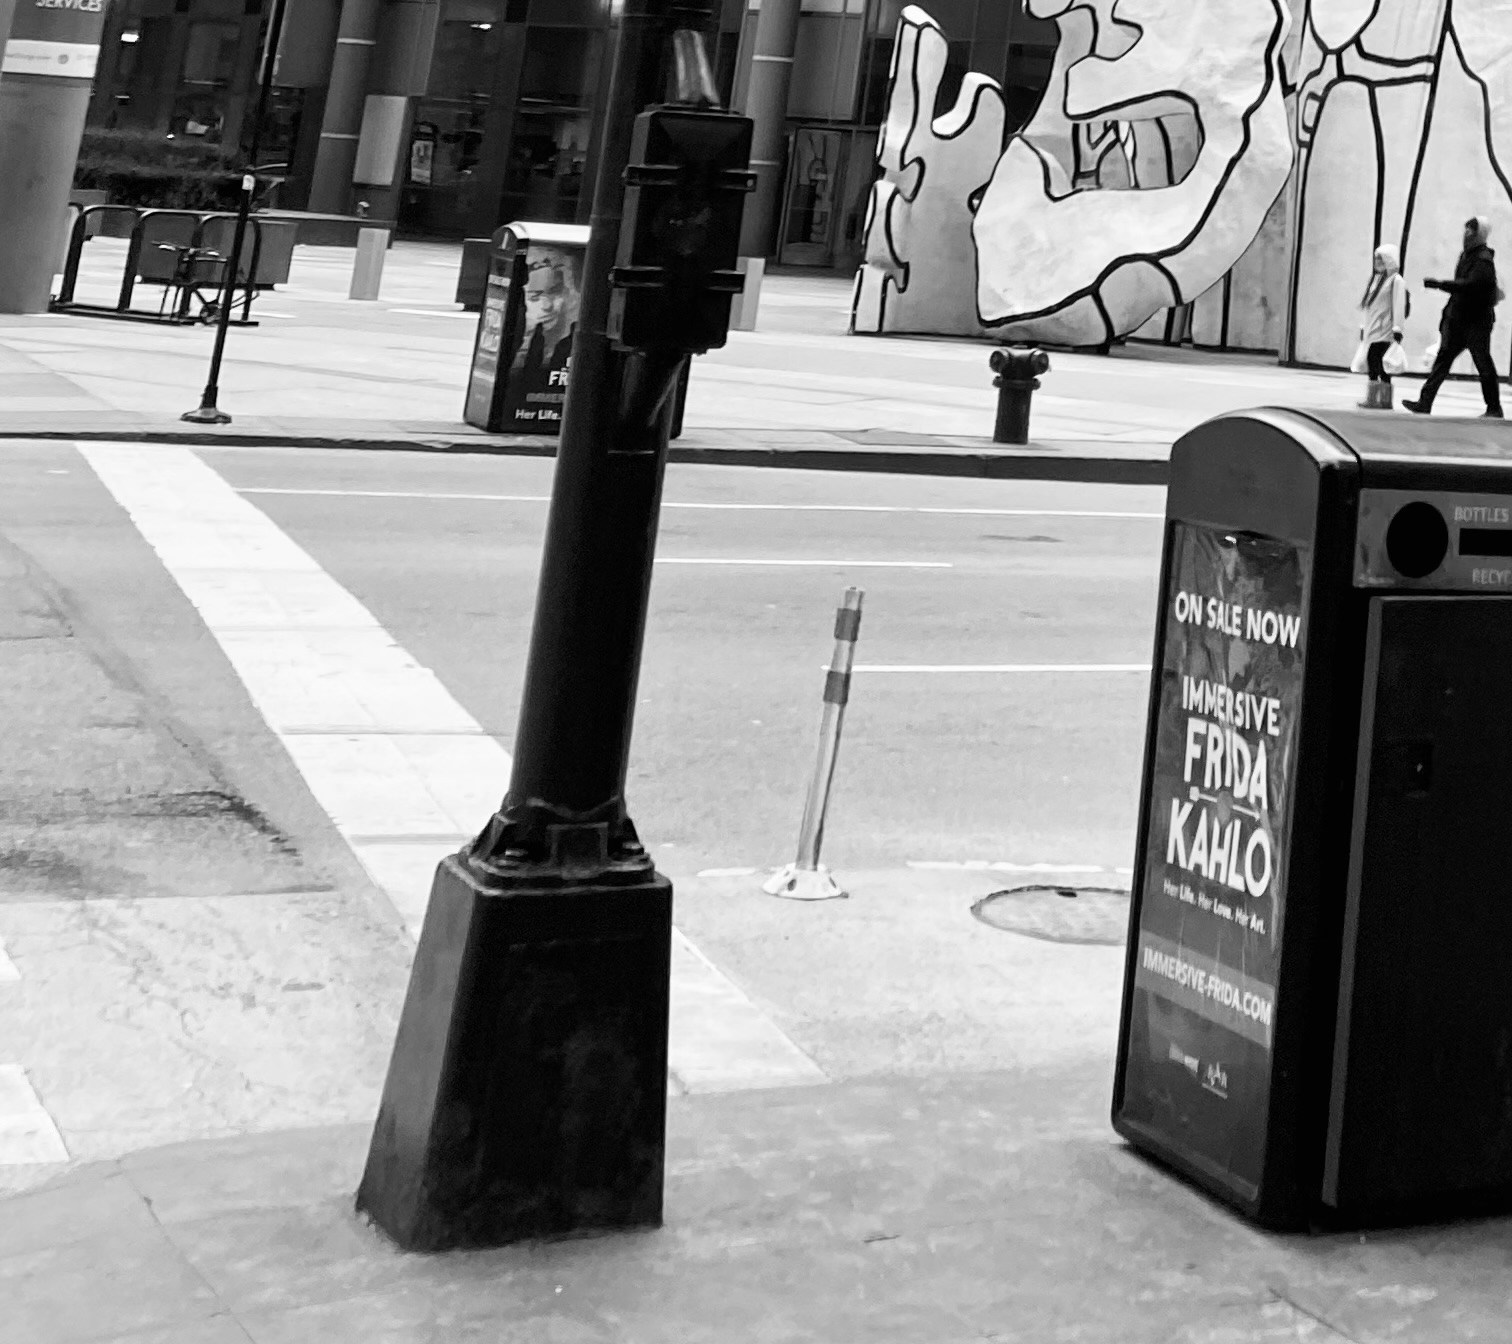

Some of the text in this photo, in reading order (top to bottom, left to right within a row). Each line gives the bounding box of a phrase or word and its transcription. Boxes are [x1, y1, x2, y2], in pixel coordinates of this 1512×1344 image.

[515, 408, 537, 420] Her
[1454, 506, 1510, 523] BOTTLES
[1174, 591, 1300, 649] ON SALE NOW
[1182, 674, 1281, 737] IMMERSIVE
[1183, 717, 1268, 810] FRIDA
[1166, 797, 1272, 899] KAHLO
[1163, 878, 1179, 898] Her
[1198, 891, 1213, 910] Her
[1235, 906, 1249, 927] Her
